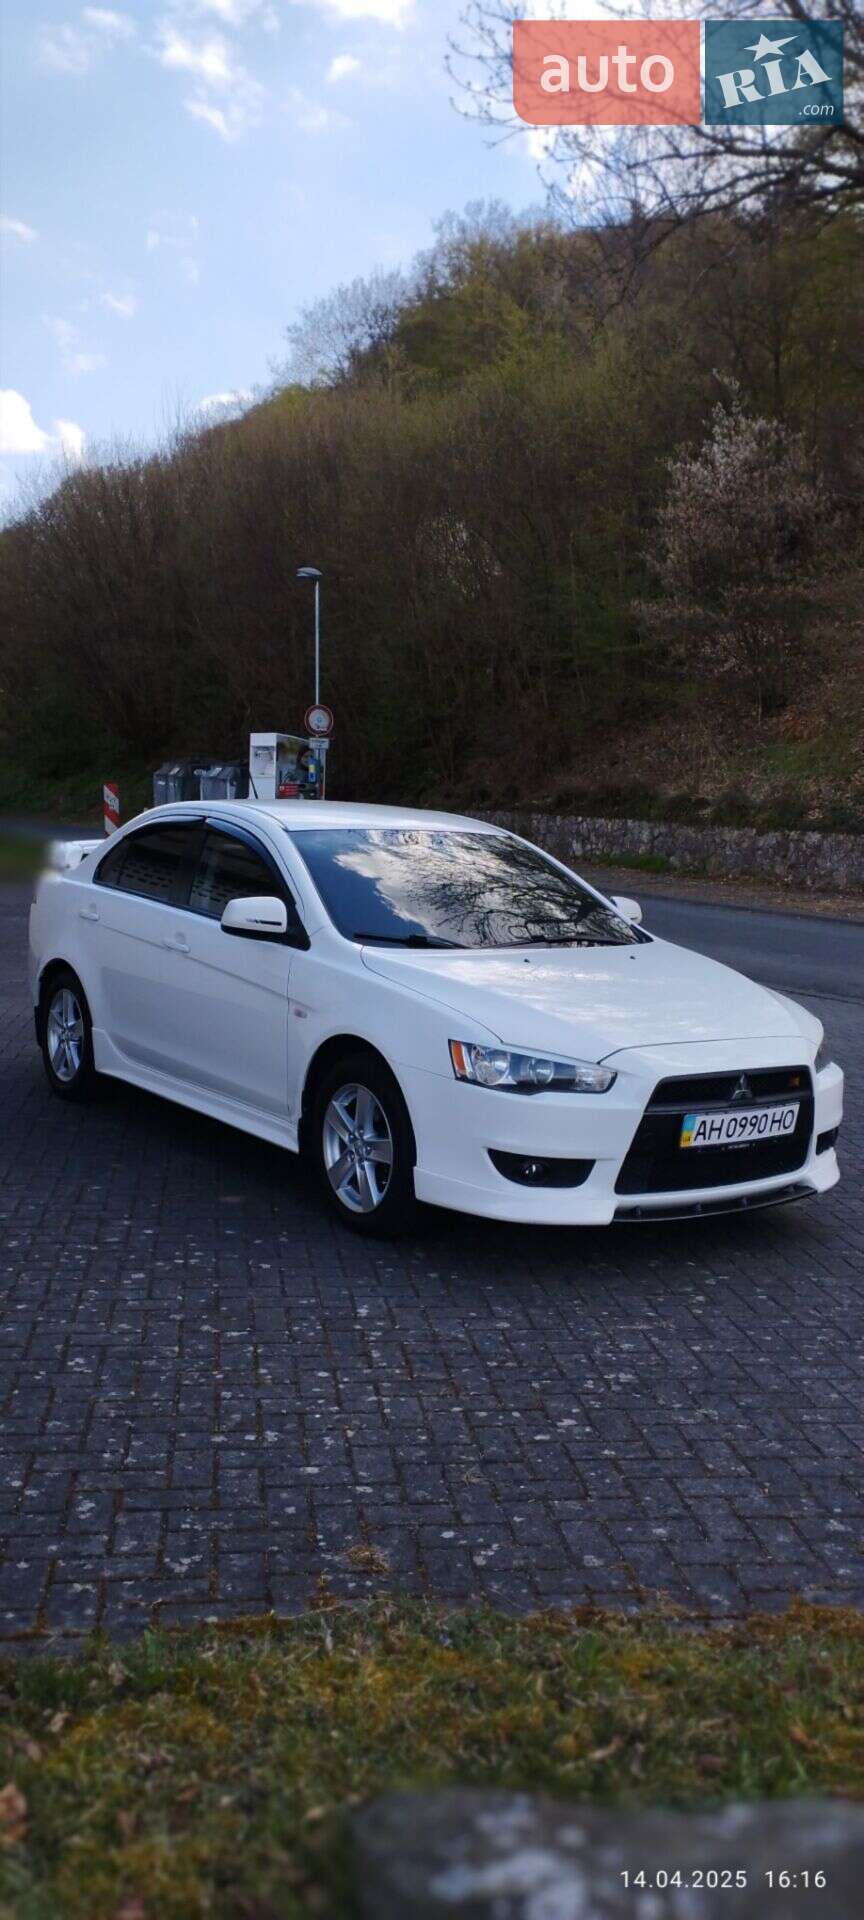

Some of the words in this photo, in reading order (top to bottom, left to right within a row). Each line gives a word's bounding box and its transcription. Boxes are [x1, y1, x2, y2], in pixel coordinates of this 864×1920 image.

[694, 1119, 724, 1141] AH
[726, 1113, 768, 1138] 0990
[769, 1109, 795, 1133] HO
